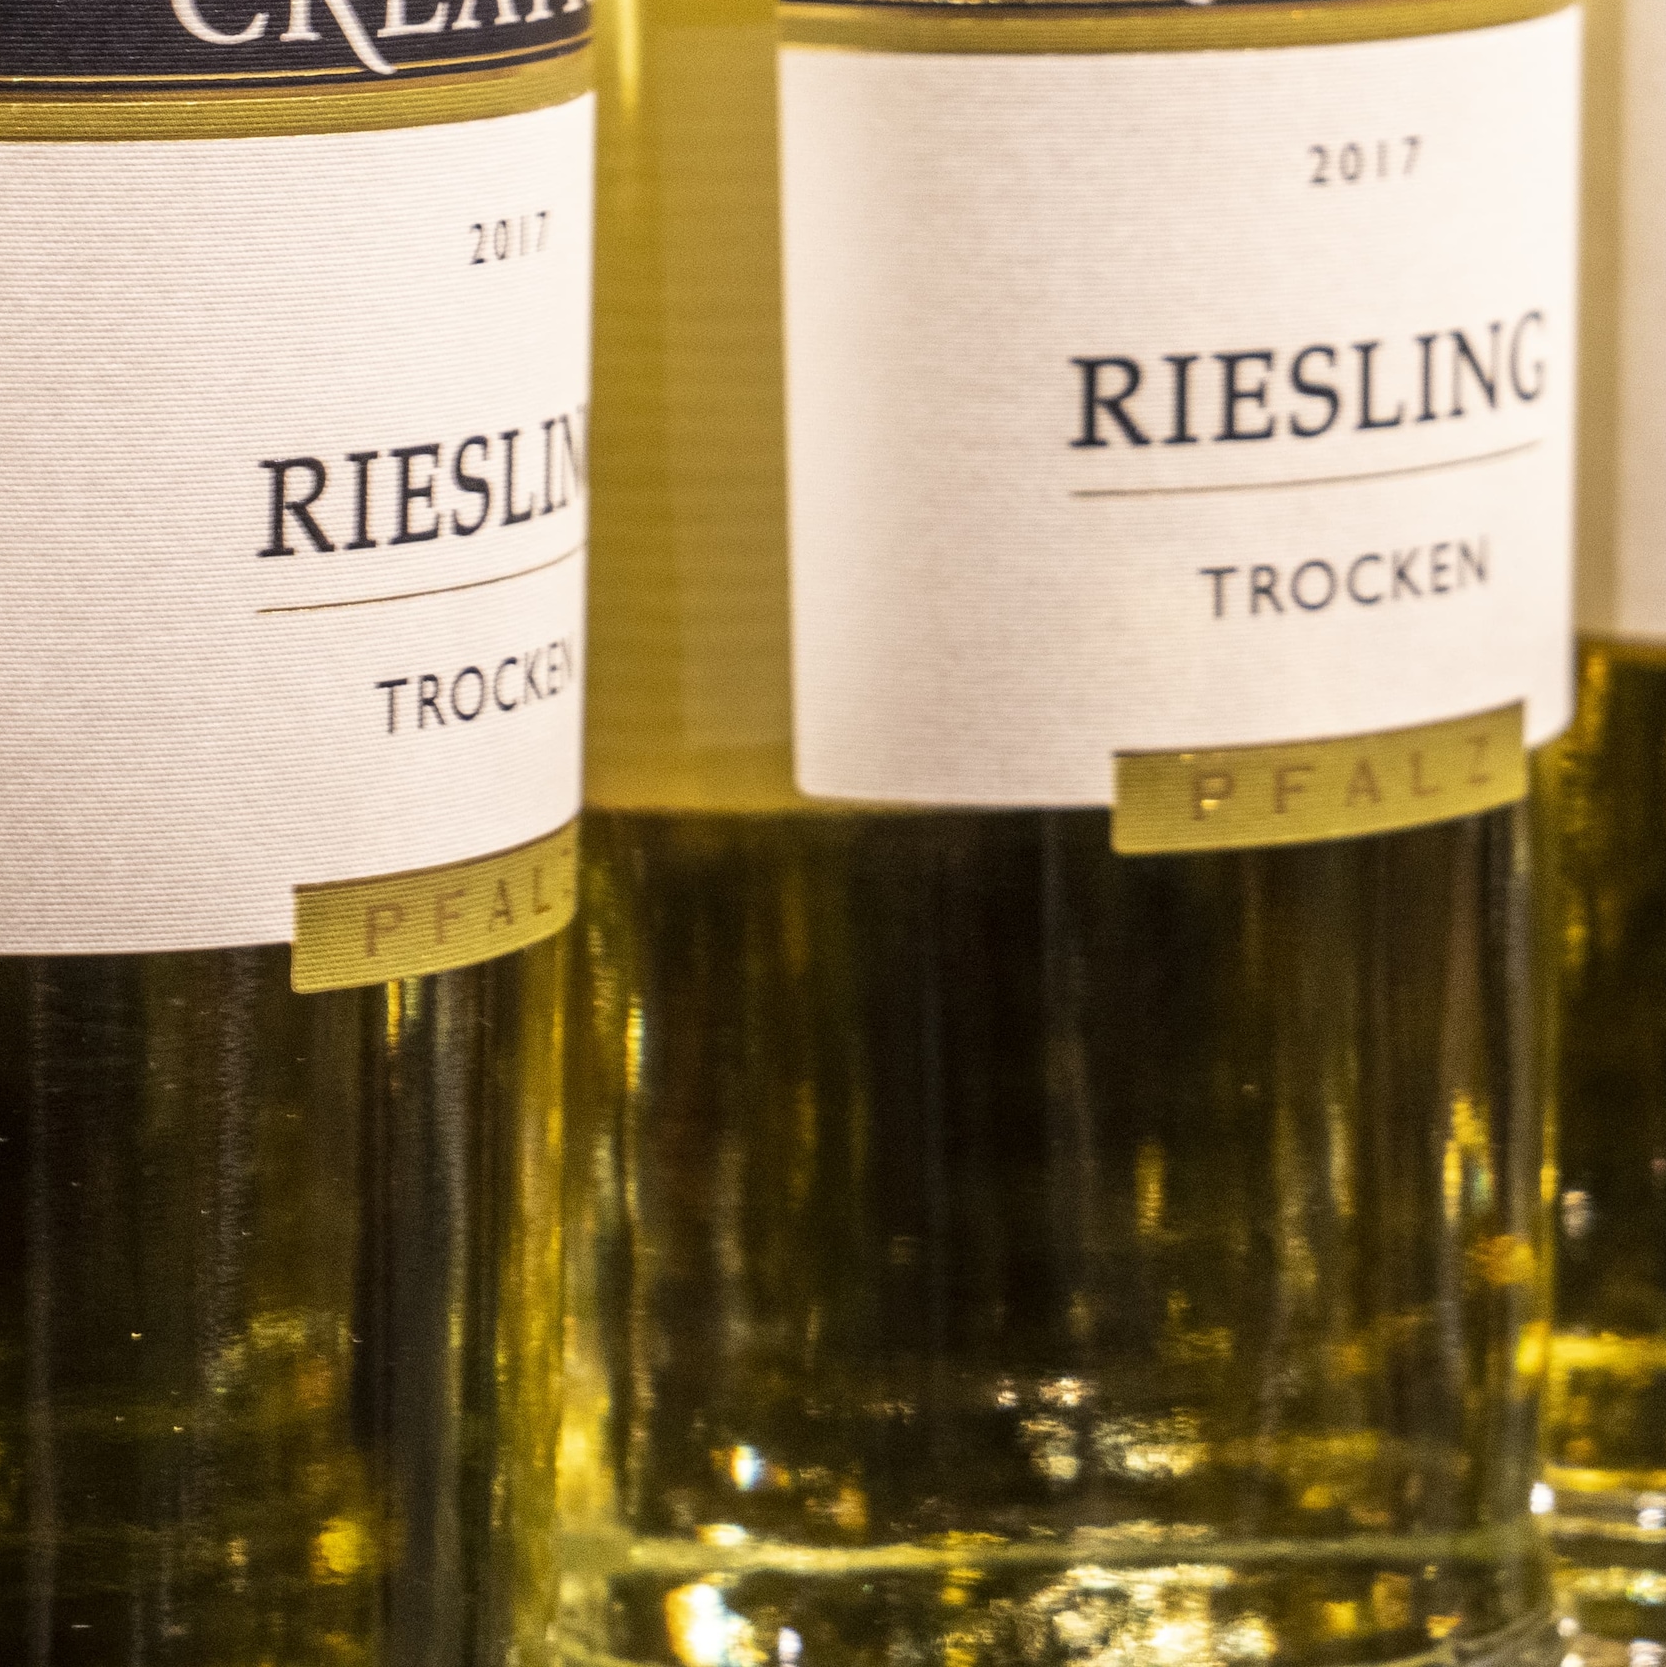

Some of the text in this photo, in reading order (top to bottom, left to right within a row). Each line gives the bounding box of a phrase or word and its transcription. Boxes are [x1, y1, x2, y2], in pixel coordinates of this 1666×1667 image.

[1308, 135, 1422, 187] 2017
[470, 210, 550, 265] 2017
[1068, 310, 1545, 449] RIESLING
[1197, 536, 1487, 618] TROCKEN
[1192, 734, 1491, 821] PFALZ
